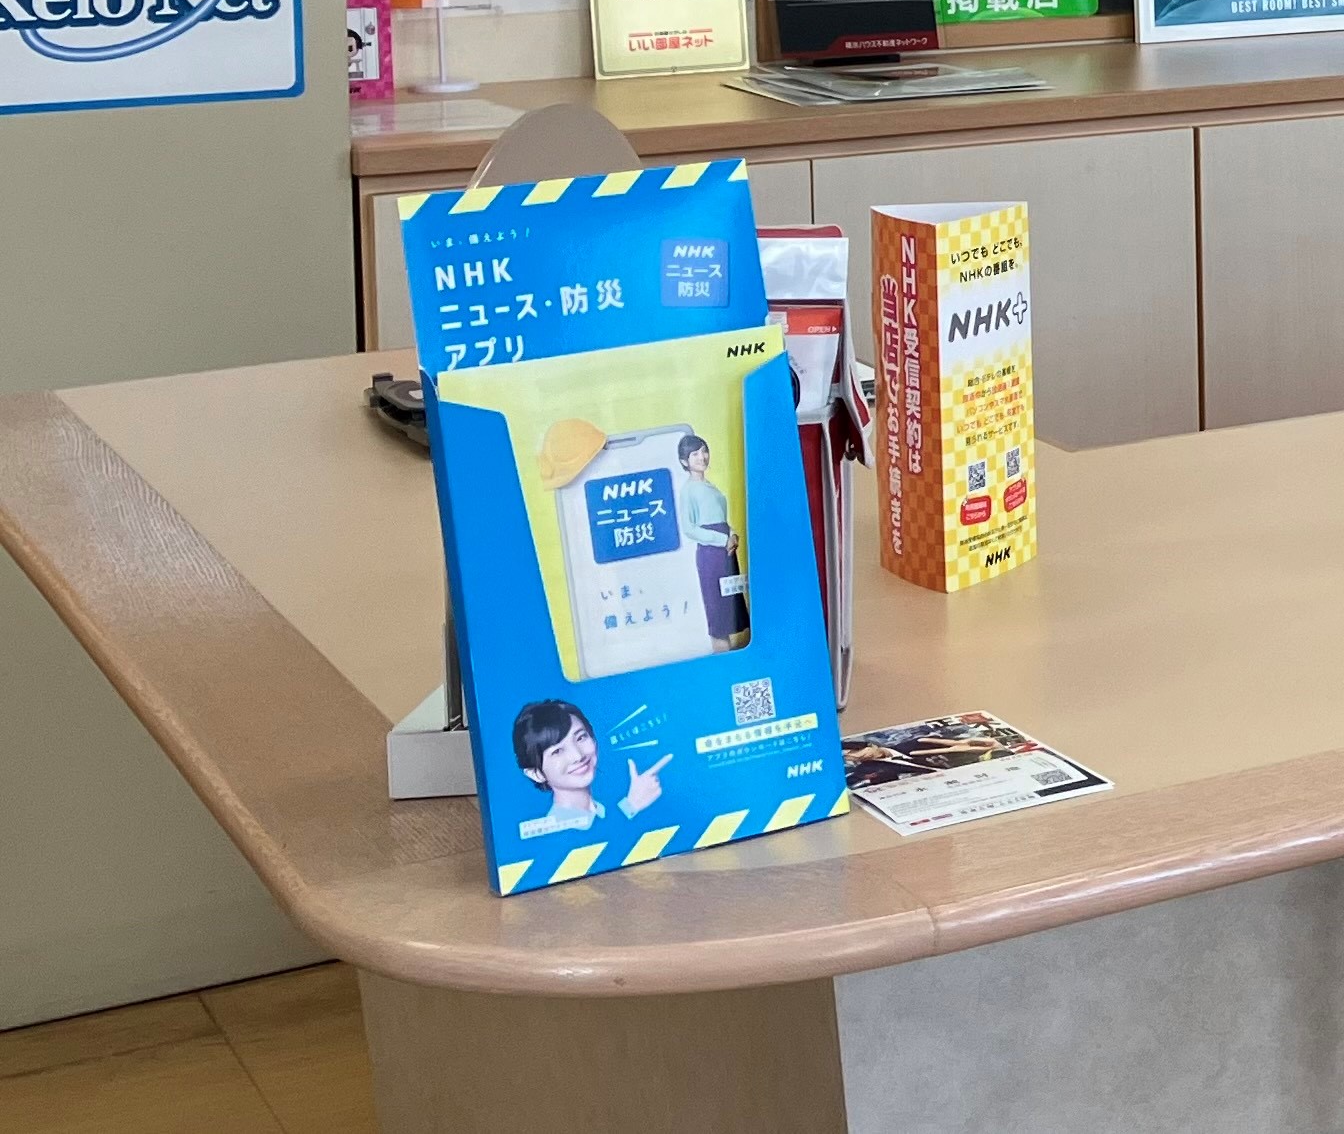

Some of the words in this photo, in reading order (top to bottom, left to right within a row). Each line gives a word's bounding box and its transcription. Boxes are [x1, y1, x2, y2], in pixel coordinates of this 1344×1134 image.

[1231, 0, 1258, 14] BEST
[628, 35, 714, 52] いい部屋ネット
[673, 244, 716, 259] NHK
[951, 246, 989, 265] いつでも
[435, 257, 514, 292] NHK
[666, 265, 723, 279] ニュース
[959, 259, 1019, 283] NHKの番組を。
[678, 281, 710, 298] 防災
[440, 279, 625, 331] ニュース・防災
[442, 335, 526, 371] アプリ
[727, 341, 766, 359] NHK
[901, 235, 923, 474] NHK受信契約は
[602, 478, 653, 501] NHK
[596, 501, 667, 523] ニュース
[614, 522, 655, 546] 防災
[985, 545, 1011, 568] NHK
[787, 759, 823, 779] NHK
